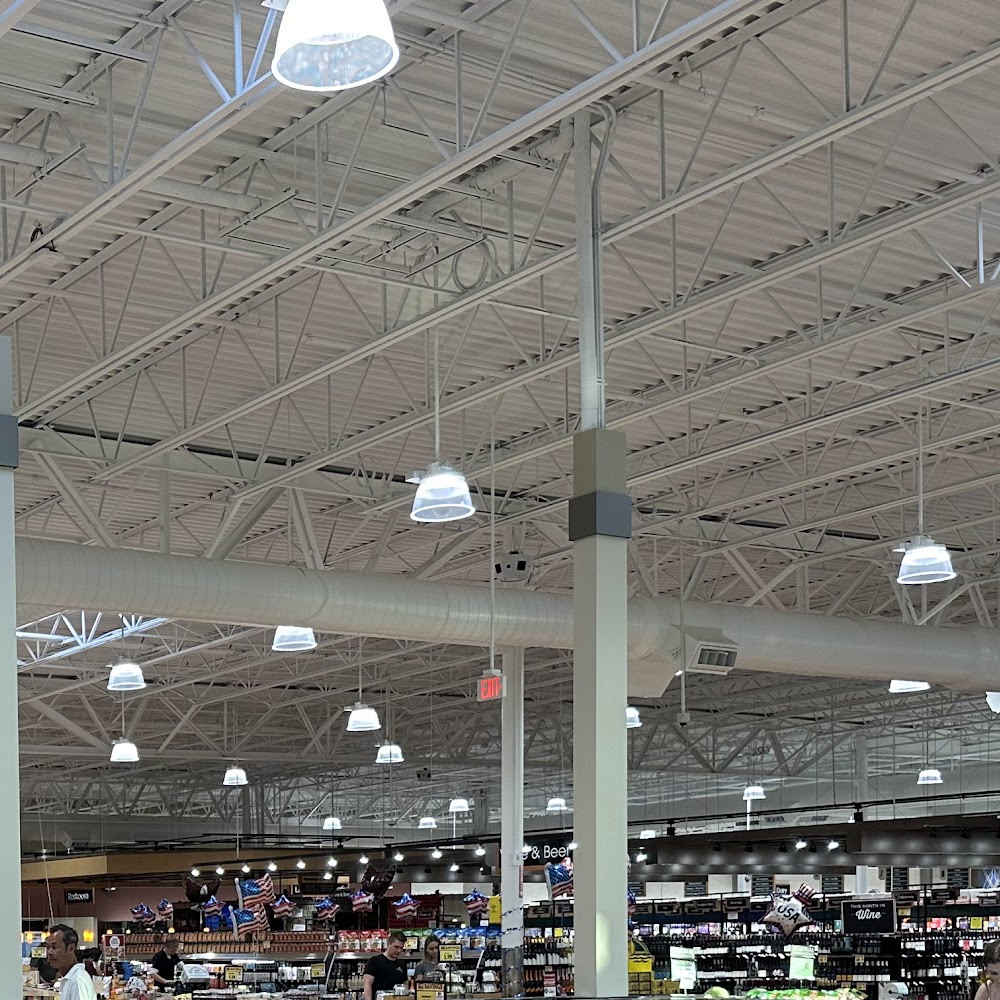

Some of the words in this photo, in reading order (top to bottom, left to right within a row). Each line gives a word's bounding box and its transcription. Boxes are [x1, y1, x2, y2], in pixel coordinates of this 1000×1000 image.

[481, 676, 500, 700] EXIT
[531, 846, 540, 859] &
[543, 845, 569, 859] Beer
[776, 904, 801, 925] USA
[855, 909, 881, 920] Wine
